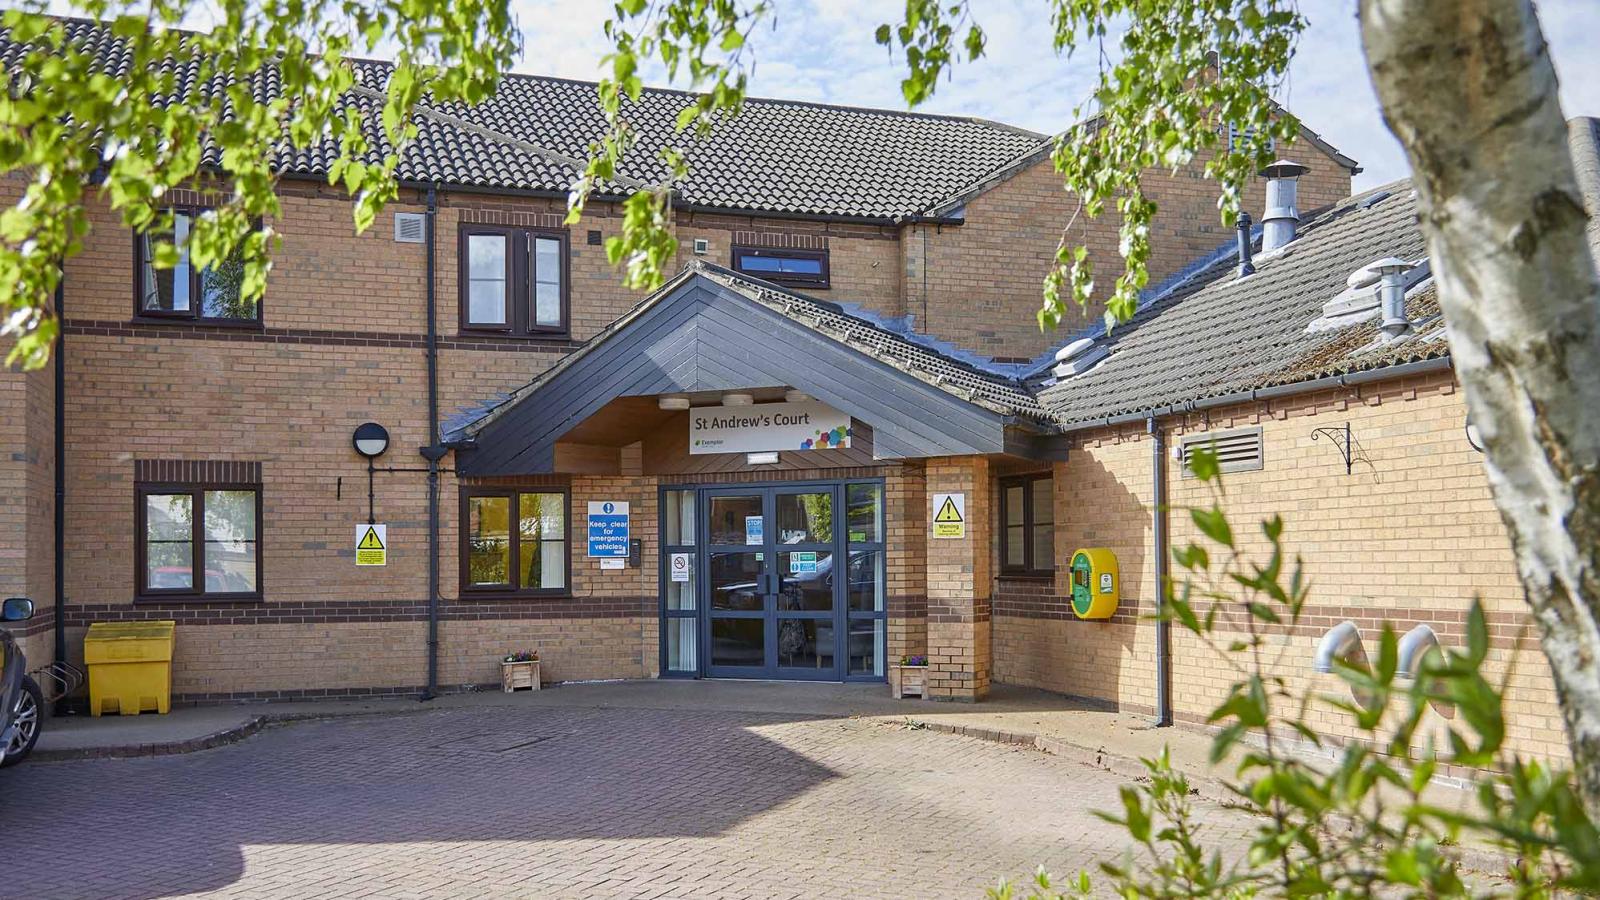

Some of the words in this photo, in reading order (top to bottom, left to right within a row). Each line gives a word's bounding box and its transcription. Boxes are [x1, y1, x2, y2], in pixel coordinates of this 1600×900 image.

[695, 417, 708, 430] St
[711, 414, 770, 429] Andrew's
[773, 412, 810, 426] Court
